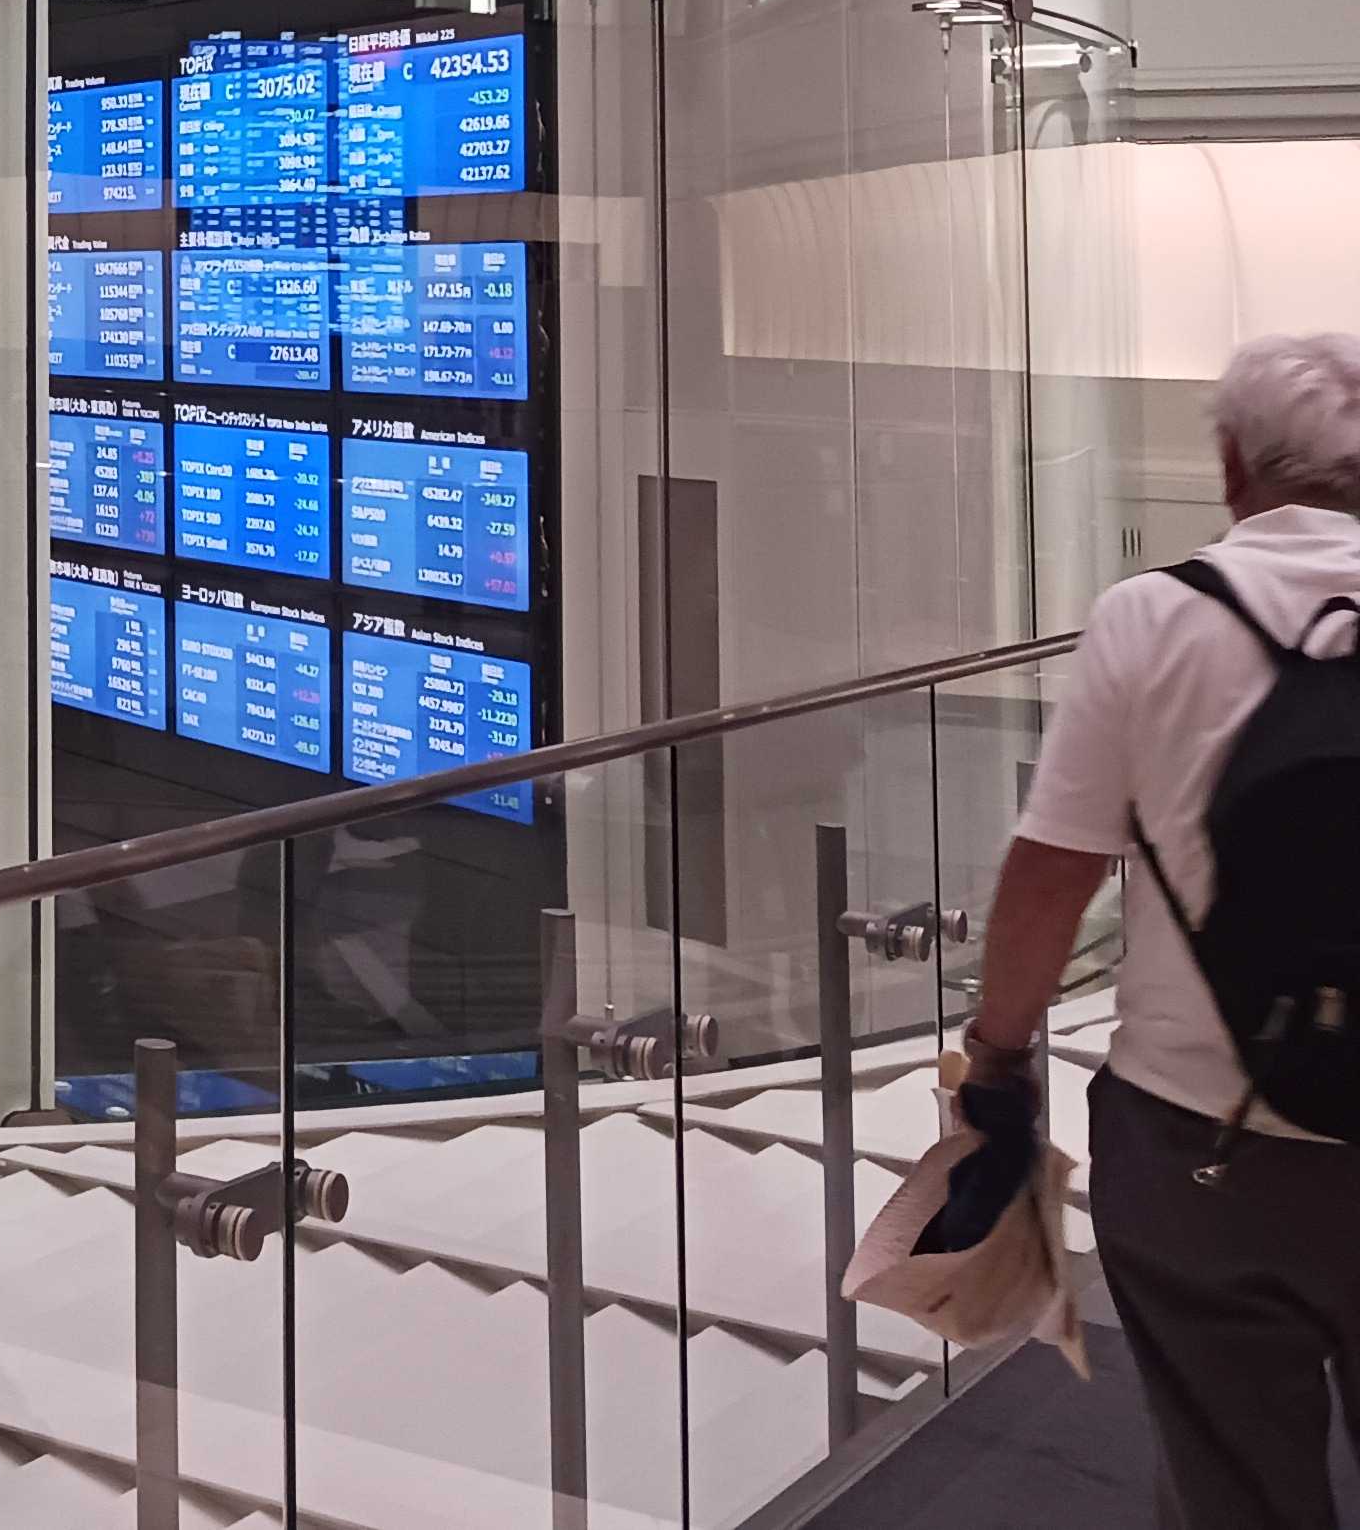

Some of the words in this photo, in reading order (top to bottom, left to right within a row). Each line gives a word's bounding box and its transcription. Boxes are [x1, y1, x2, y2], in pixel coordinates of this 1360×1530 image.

[180, 55, 214, 75] TOPIX
[403, 63, 413, 80] C
[430, 49, 510, 79] 42354.53
[257, 72, 316, 100] 3075.02
[468, 89, 509, 105] -453.29
[459, 115, 510, 133] 42619.66
[459, 140, 511, 157] 42703.27
[459, 165, 511, 182] 42137.62
[270, 346, 319, 362] 27613.48
[352, 419, 414, 439] アメリカ指数
[352, 612, 405, 638] アジア指数
